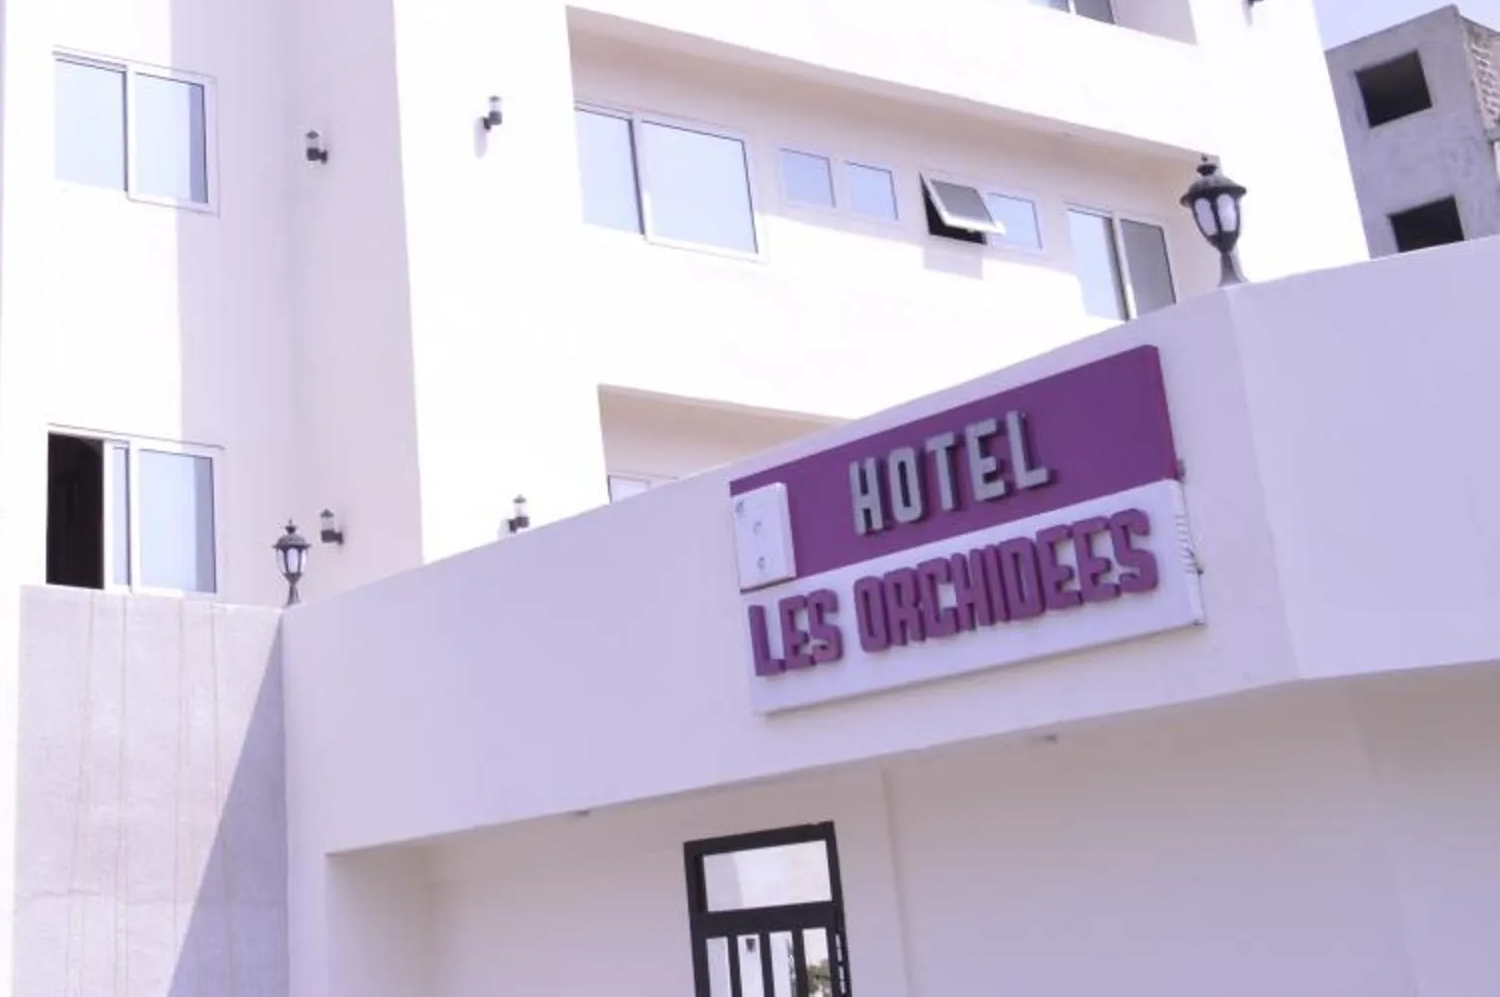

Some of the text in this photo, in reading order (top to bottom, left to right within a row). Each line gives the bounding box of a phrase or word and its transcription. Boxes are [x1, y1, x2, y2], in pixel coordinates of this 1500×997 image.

[849, 410, 1052, 536] HOTEL
[748, 508, 1160, 677] LES ORCHIDEES
